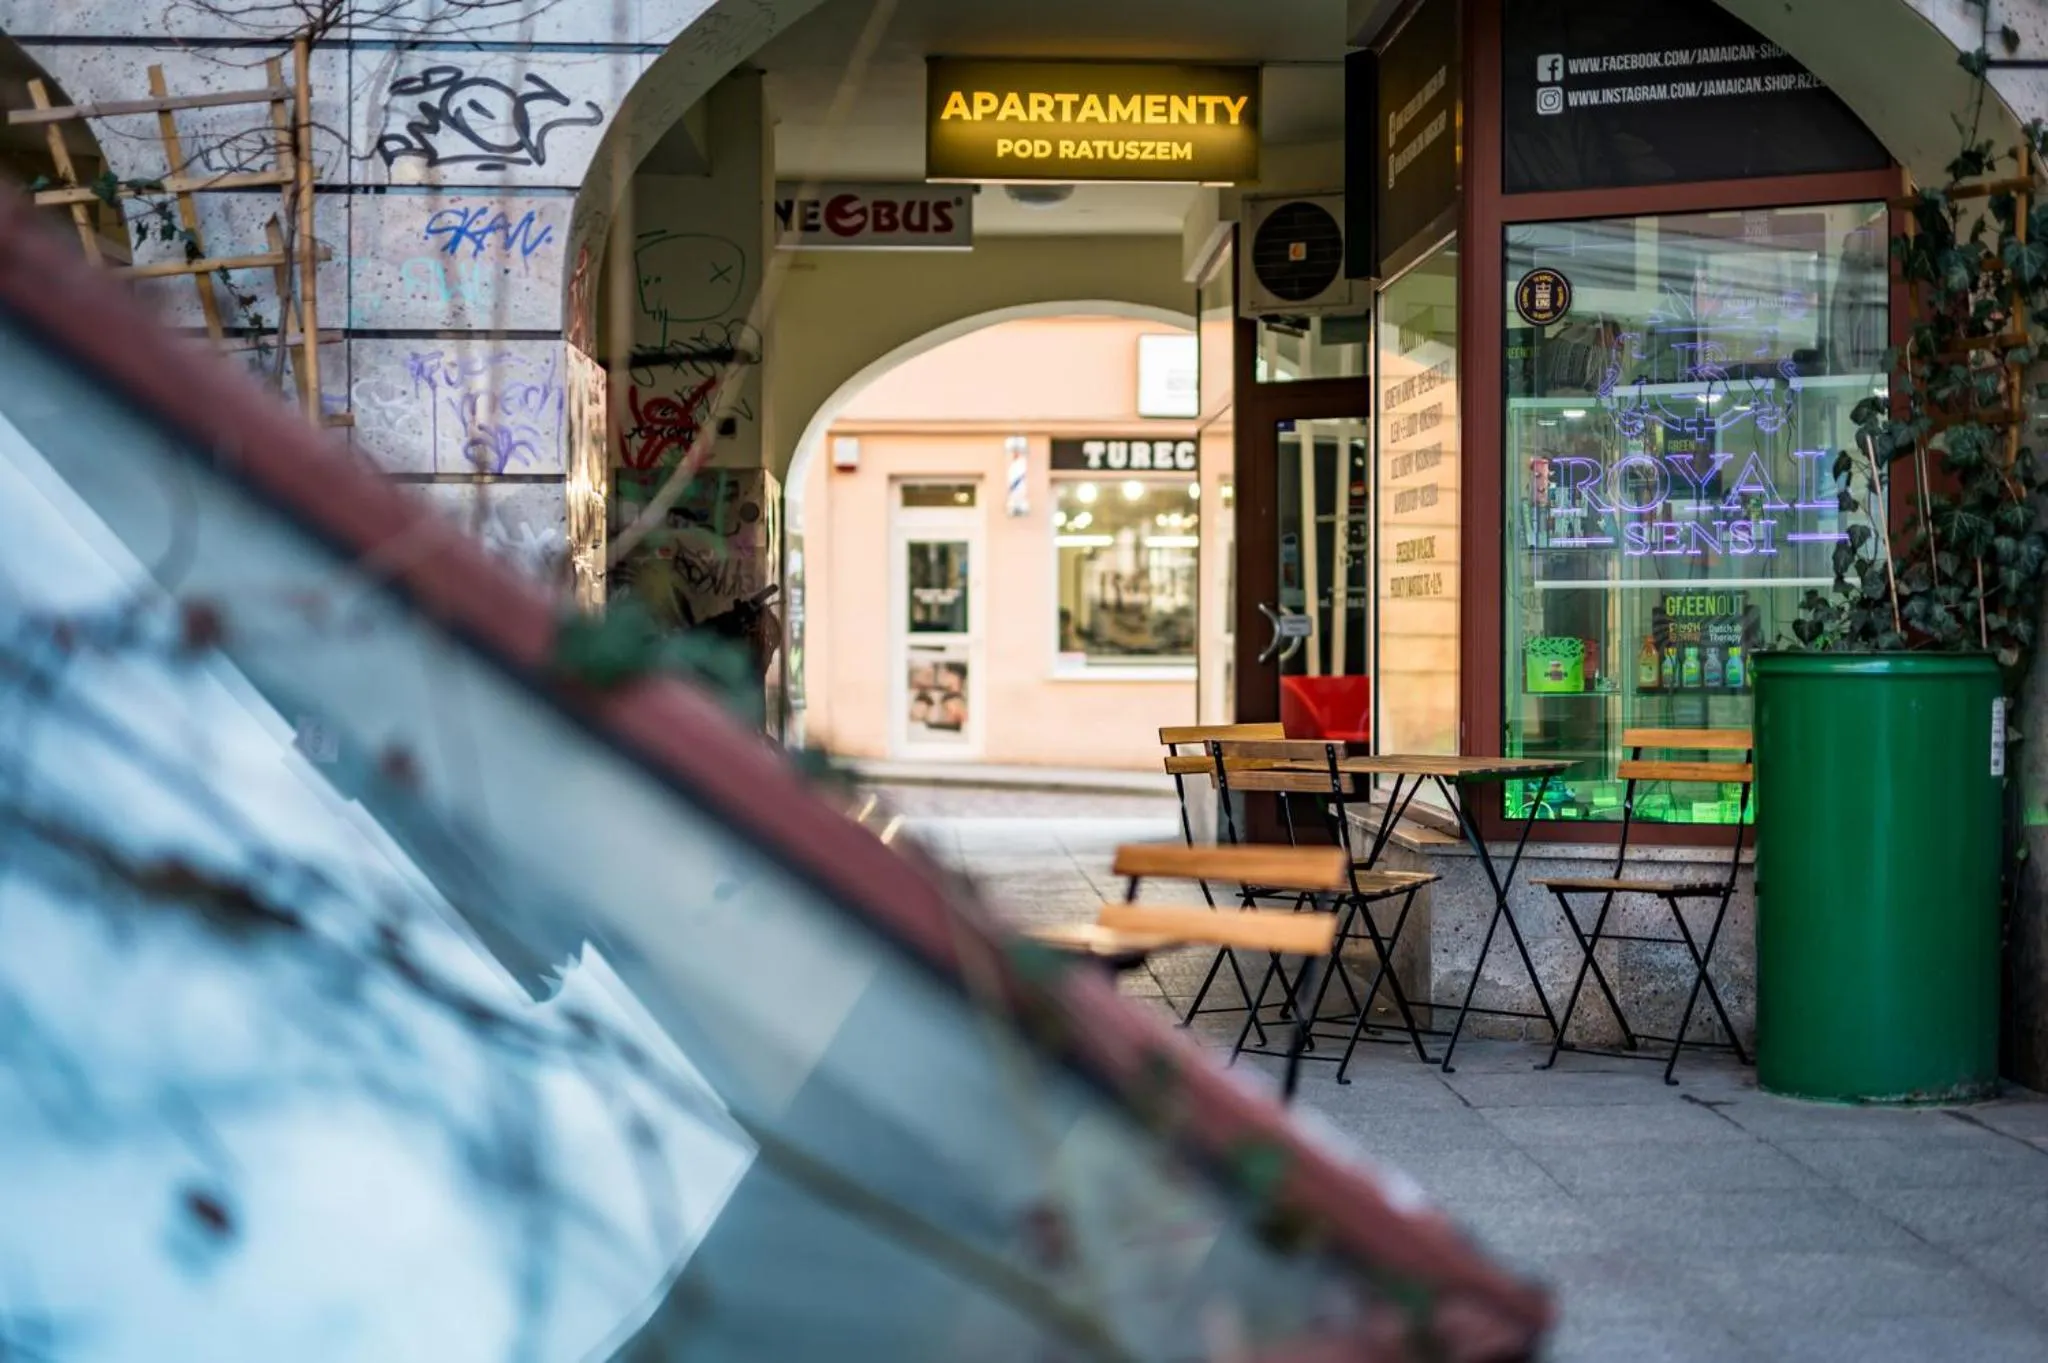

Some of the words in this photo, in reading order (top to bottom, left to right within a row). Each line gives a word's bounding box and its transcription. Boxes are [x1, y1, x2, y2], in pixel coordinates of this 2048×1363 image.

[1568, 43, 1790, 75] WWW.FACEBOOK.COM/JAMAICAN-SHO
[1567, 73, 1826, 107] WWW.INSTAGRAM.COM/JAMAICAN.SHOP.RZE
[940, 91, 1248, 125] APARTAMENTY
[996, 138, 1052, 159] POD
[1058, 141, 1193, 161] RATUSZEM
[1082, 440, 1196, 469] TUREC
[1551, 451, 1840, 512] ROYAL
[1625, 519, 1777, 556] SENSI
[1666, 595, 1744, 616] GREENOUT
